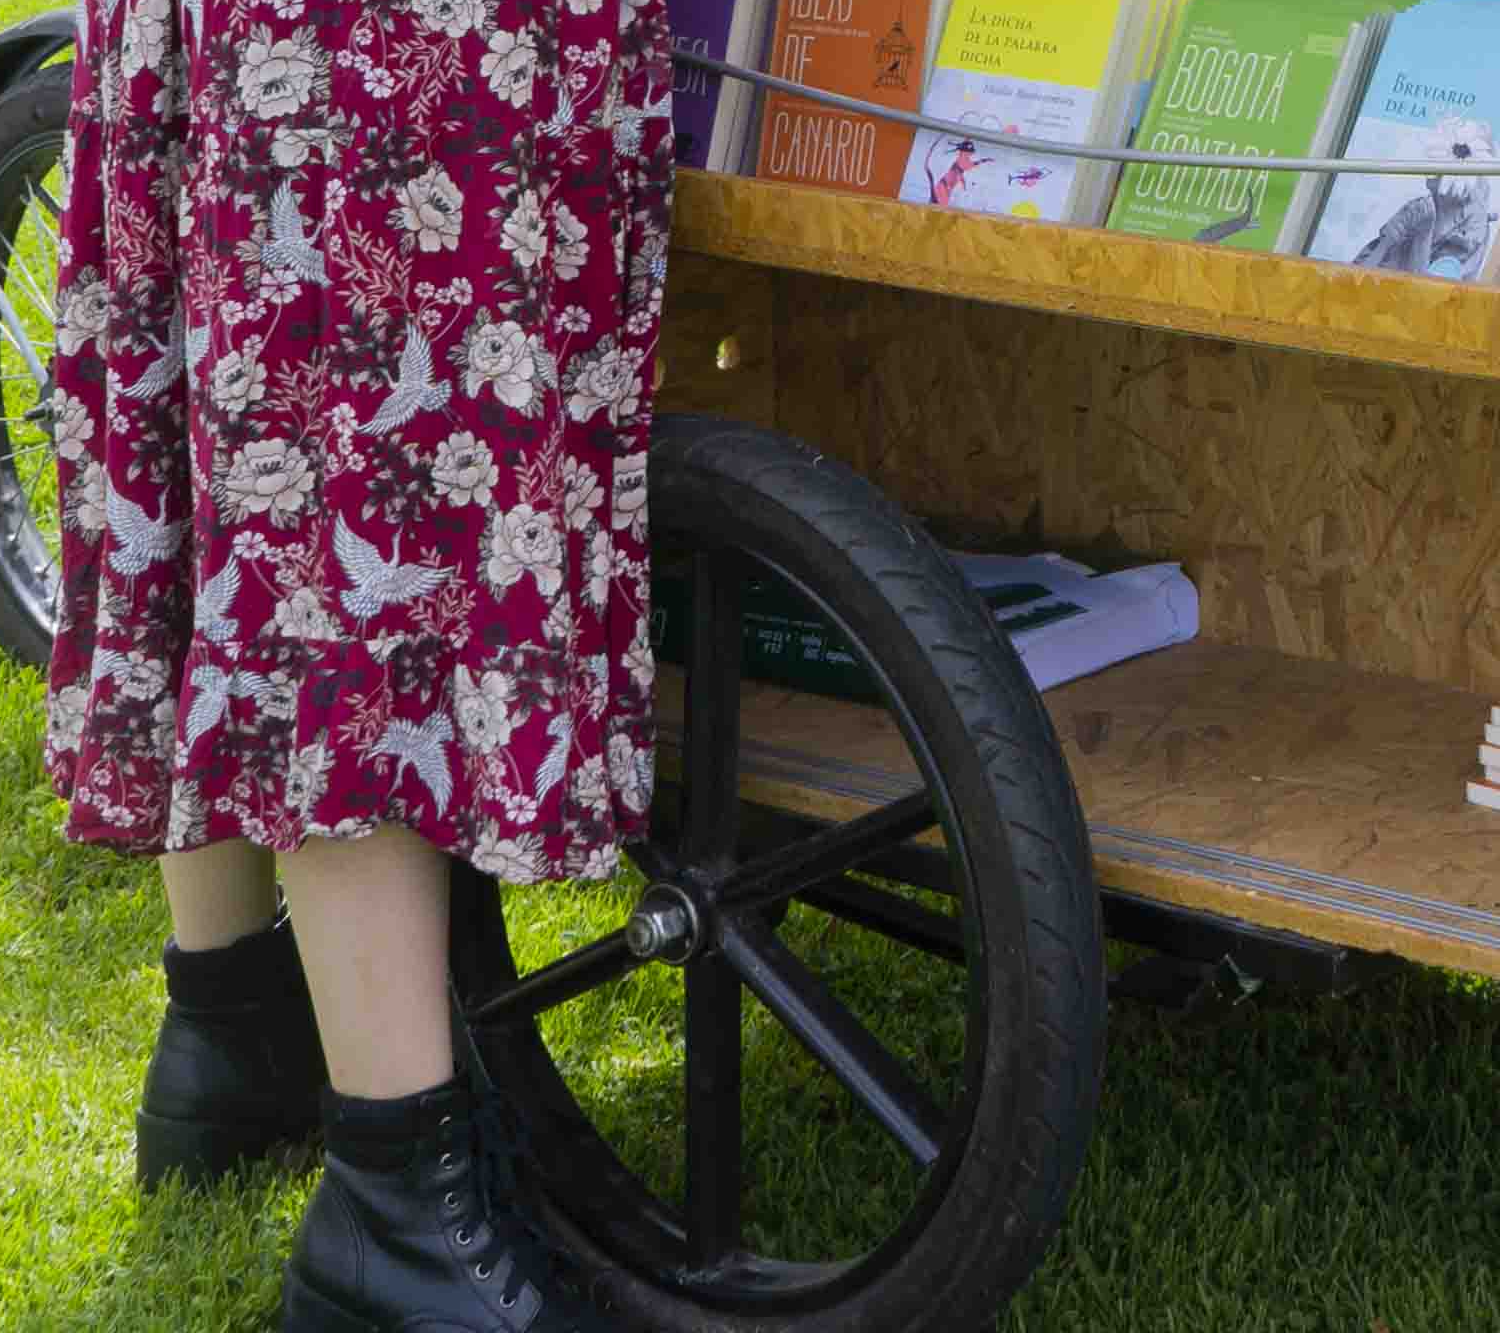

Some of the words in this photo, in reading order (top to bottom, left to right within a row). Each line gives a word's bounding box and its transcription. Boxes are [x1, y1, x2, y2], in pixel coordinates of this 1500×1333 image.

[968, 5, 987, 25] LA
[987, 13, 1034, 31] DICHA
[781, 34, 817, 85] DE
[959, 49, 1002, 68] DICHA
[964, 30, 980, 44] DE
[985, 34, 1000, 47] LA
[1003, 36, 1058, 55] PALABRA
[1165, 44, 1294, 125] BOGOTÁ
[1392, 72, 1477, 107] BREVIARIO
[1385, 98, 1404, 114] DE
[1410, 102, 1427, 118] LA
[770, 111, 876, 187] CANARIO
[1135, 131, 1276, 218] CONTADA
